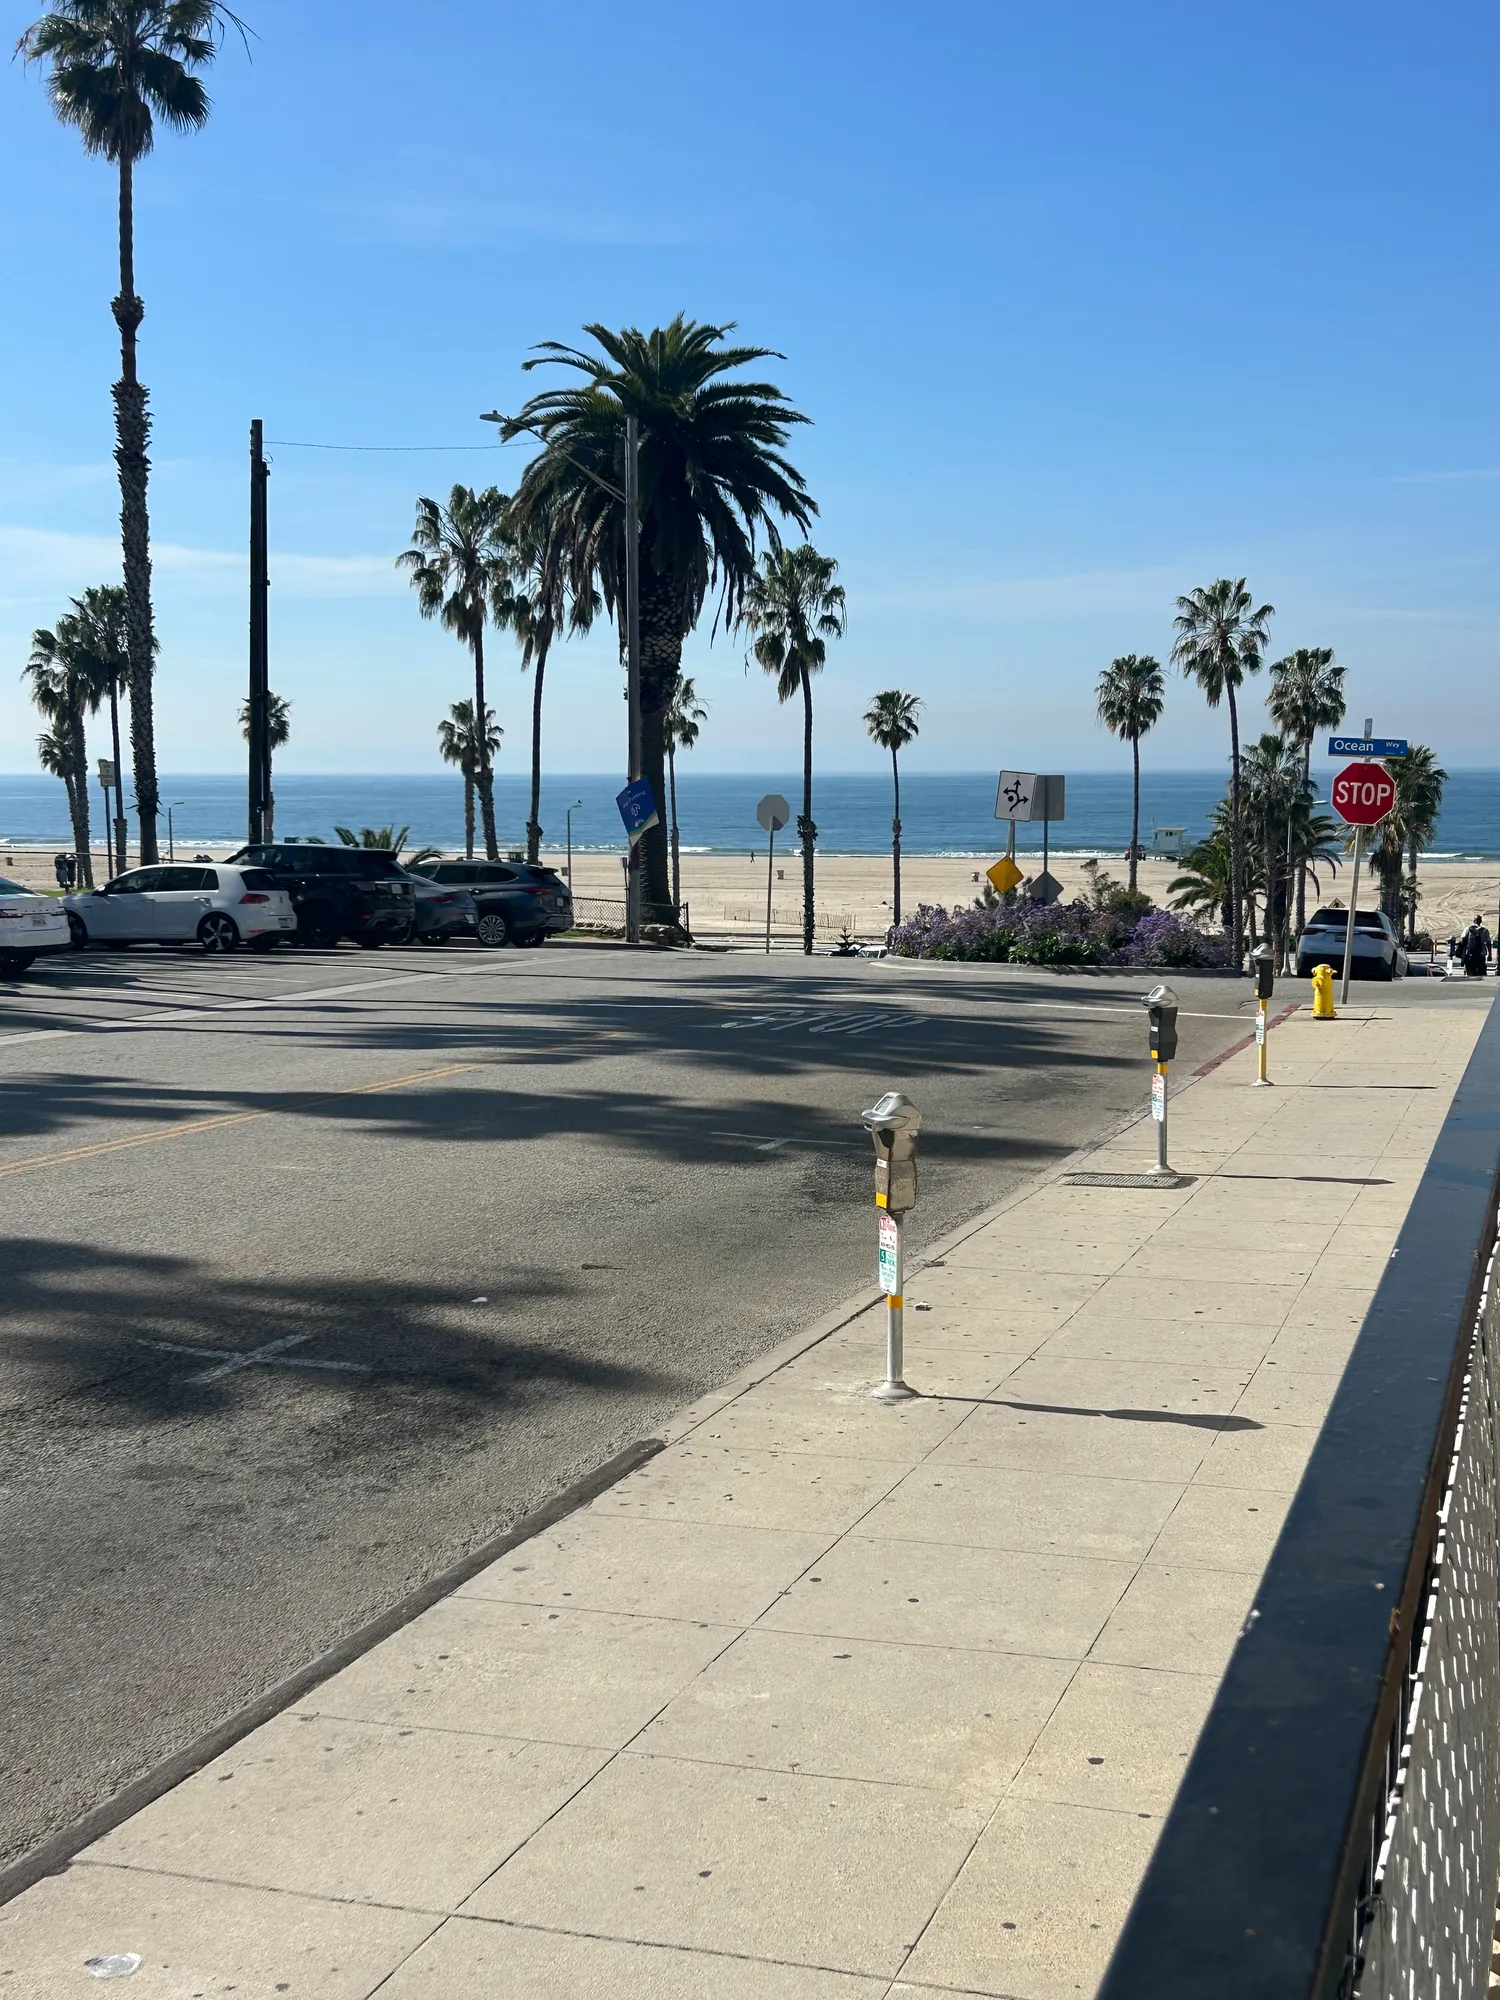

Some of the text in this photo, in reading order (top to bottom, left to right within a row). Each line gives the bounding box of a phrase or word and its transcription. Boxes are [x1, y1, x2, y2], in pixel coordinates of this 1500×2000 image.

[1334, 740, 1374, 752] Ocean
[1336, 781, 1391, 806] STOP
[721, 1010, 930, 1034] STOP
